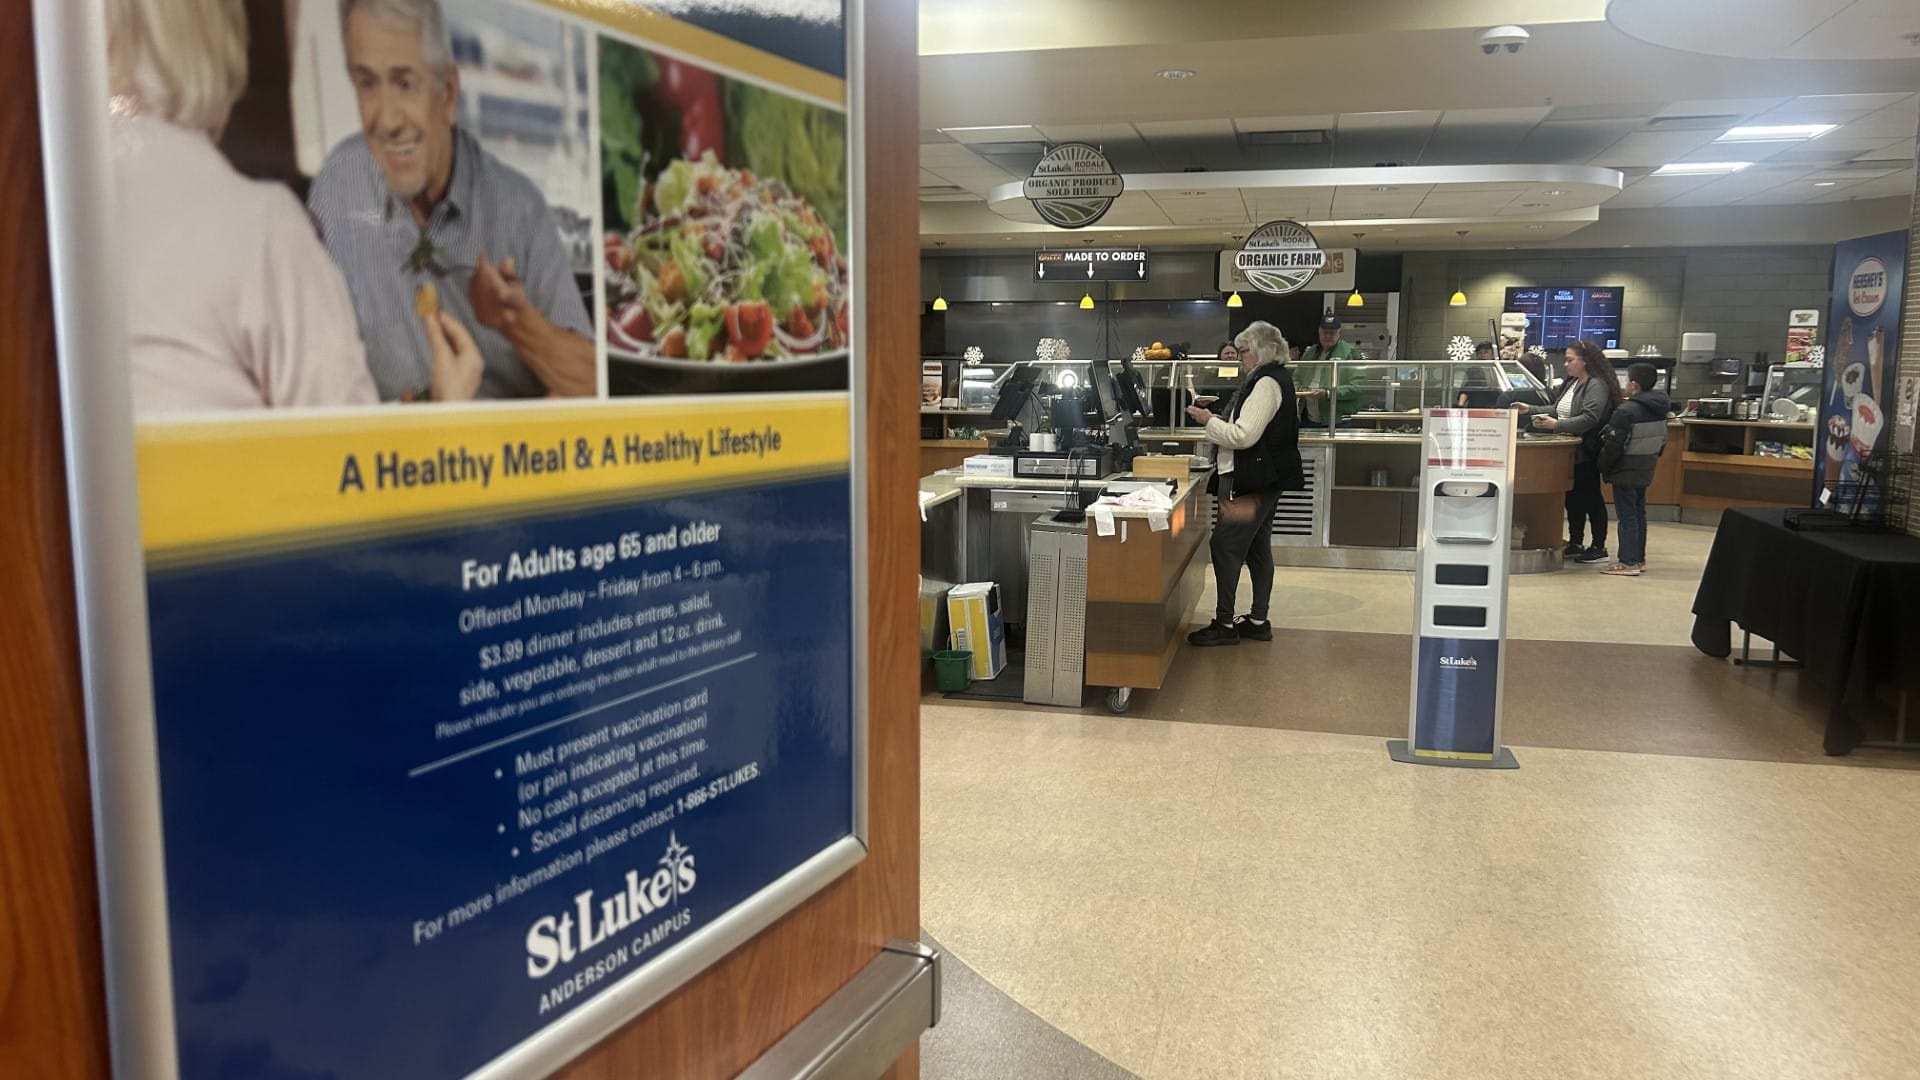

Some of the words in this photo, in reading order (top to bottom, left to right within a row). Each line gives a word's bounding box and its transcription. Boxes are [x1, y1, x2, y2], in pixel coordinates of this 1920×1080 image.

[1028, 178, 1071, 189] ORGANIC
[1072, 177, 1119, 187] PRODUCE
[1046, 187, 1070, 197] SOLD
[1072, 187, 1101, 196] HERE
[1063, 251, 1094, 262] MADE
[1095, 252, 1110, 262] TO
[1111, 251, 1147, 262] ORDER
[1238, 252, 1289, 267] ORGANIC
[1290, 252, 1322, 266] FARM
[339, 452, 365, 493] A
[376, 445, 494, 489] Healthy
[502, 438, 567, 477] Meal
[575, 436, 593, 469] &
[601, 433, 618, 467] A
[624, 430, 703, 466] Healthy
[708, 424, 781, 458] Lifestyle
[461, 558, 501, 591] For
[506, 543, 577, 582] Adults
[581, 541, 616, 571] age
[619, 530, 642, 559] 65
[645, 524, 678, 555] and
[680, 519, 722, 548] older
[458, 600, 522, 634] Offered
[524, 589, 586, 618] Monday
[598, 576, 641, 600] Friday
[641, 569, 672, 590] from
[478, 638, 524, 670] $3.99
[525, 632, 575, 657] dinner
[576, 613, 634, 642] includes
[502, 653, 581, 692] vegetable,
[582, 639, 632, 668] dessert
[633, 630, 658, 653] and
[661, 624, 675, 645] 12
[515, 745, 555, 777] Must
[557, 725, 609, 764] present
[611, 700, 683, 739] vaccination
[683, 686, 708, 713] card
[517, 805, 543, 831] No
[544, 788, 579, 820] cash
[581, 761, 640, 803] accepted
[641, 757, 654, 778] at
[655, 747, 679, 770] this
[543, 766, 568, 798] pin
[571, 741, 636, 782] indicating
[531, 813, 577, 853] Social
[578, 788, 647, 833] distancing
[649, 760, 701, 799] required.
[412, 916, 445, 946] For
[447, 892, 494, 930] more
[494, 848, 583, 904] information
[585, 827, 629, 864] please
[630, 803, 675, 838] contact
[538, 944, 630, 1016] ANDERSON
[631, 907, 692, 957] CAMPUS
